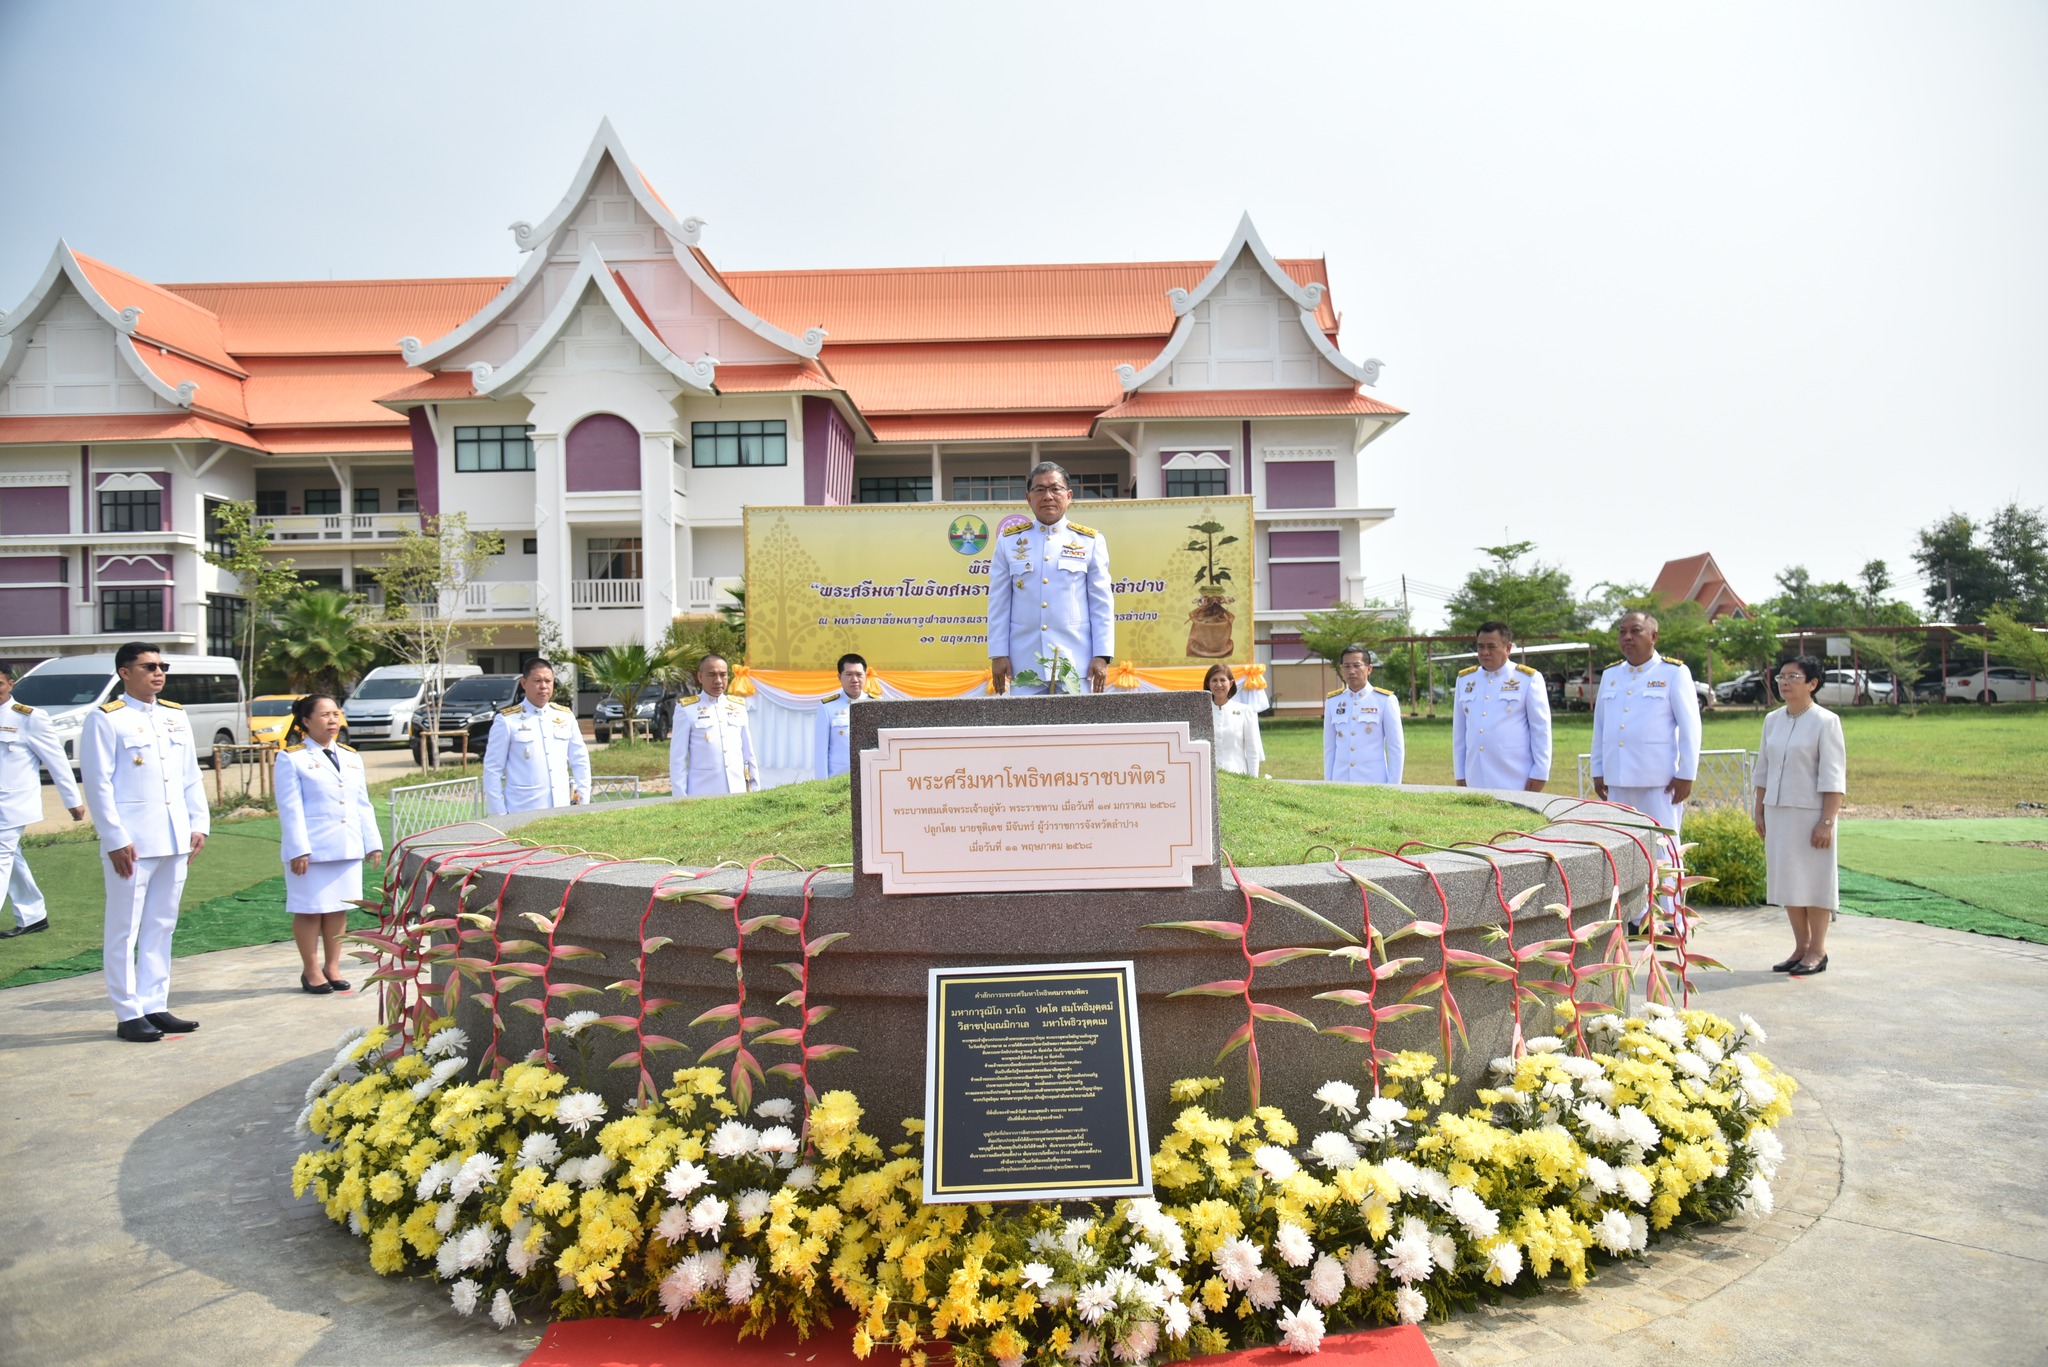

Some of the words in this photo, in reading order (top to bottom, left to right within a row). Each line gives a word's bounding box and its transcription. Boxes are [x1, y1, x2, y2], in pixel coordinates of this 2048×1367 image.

[968, 559, 991, 574] พิธี
[810, 578, 990, 598] “พระศรีมหาโพธิทศมรา
[818, 616, 828, 625] ณ
[834, 613, 989, 628] มหาวิทยาลัยมหาจุฬาลงกรณรา
[907, 764, 1166, 790] พระศรีมหาโพธิทศมราชบพิตร
[893, 803, 1006, 816] พระบาทสมเด็จพระเจ้าอยู่หัว
[1009, 804, 1058, 813] พระราชทาน
[1061, 798, 1094, 811] เมื่อวันที่
[1113, 802, 1147, 810] มกราคม
[1149, 801, 1176, 809] ๒๕๖๘
[923, 823, 957, 836] ปลูกโดย
[1005, 820, 1035, 832] มีจันทร์
[1037, 818, 1139, 834] ผู้ว่าราชการจังหวัดลำปาง
[969, 840, 1002, 852] เมื่อวันที่
[1021, 842, 1063, 853] พฤษภาคม
[1066, 841, 1093, 850] ๒๕๖๘
